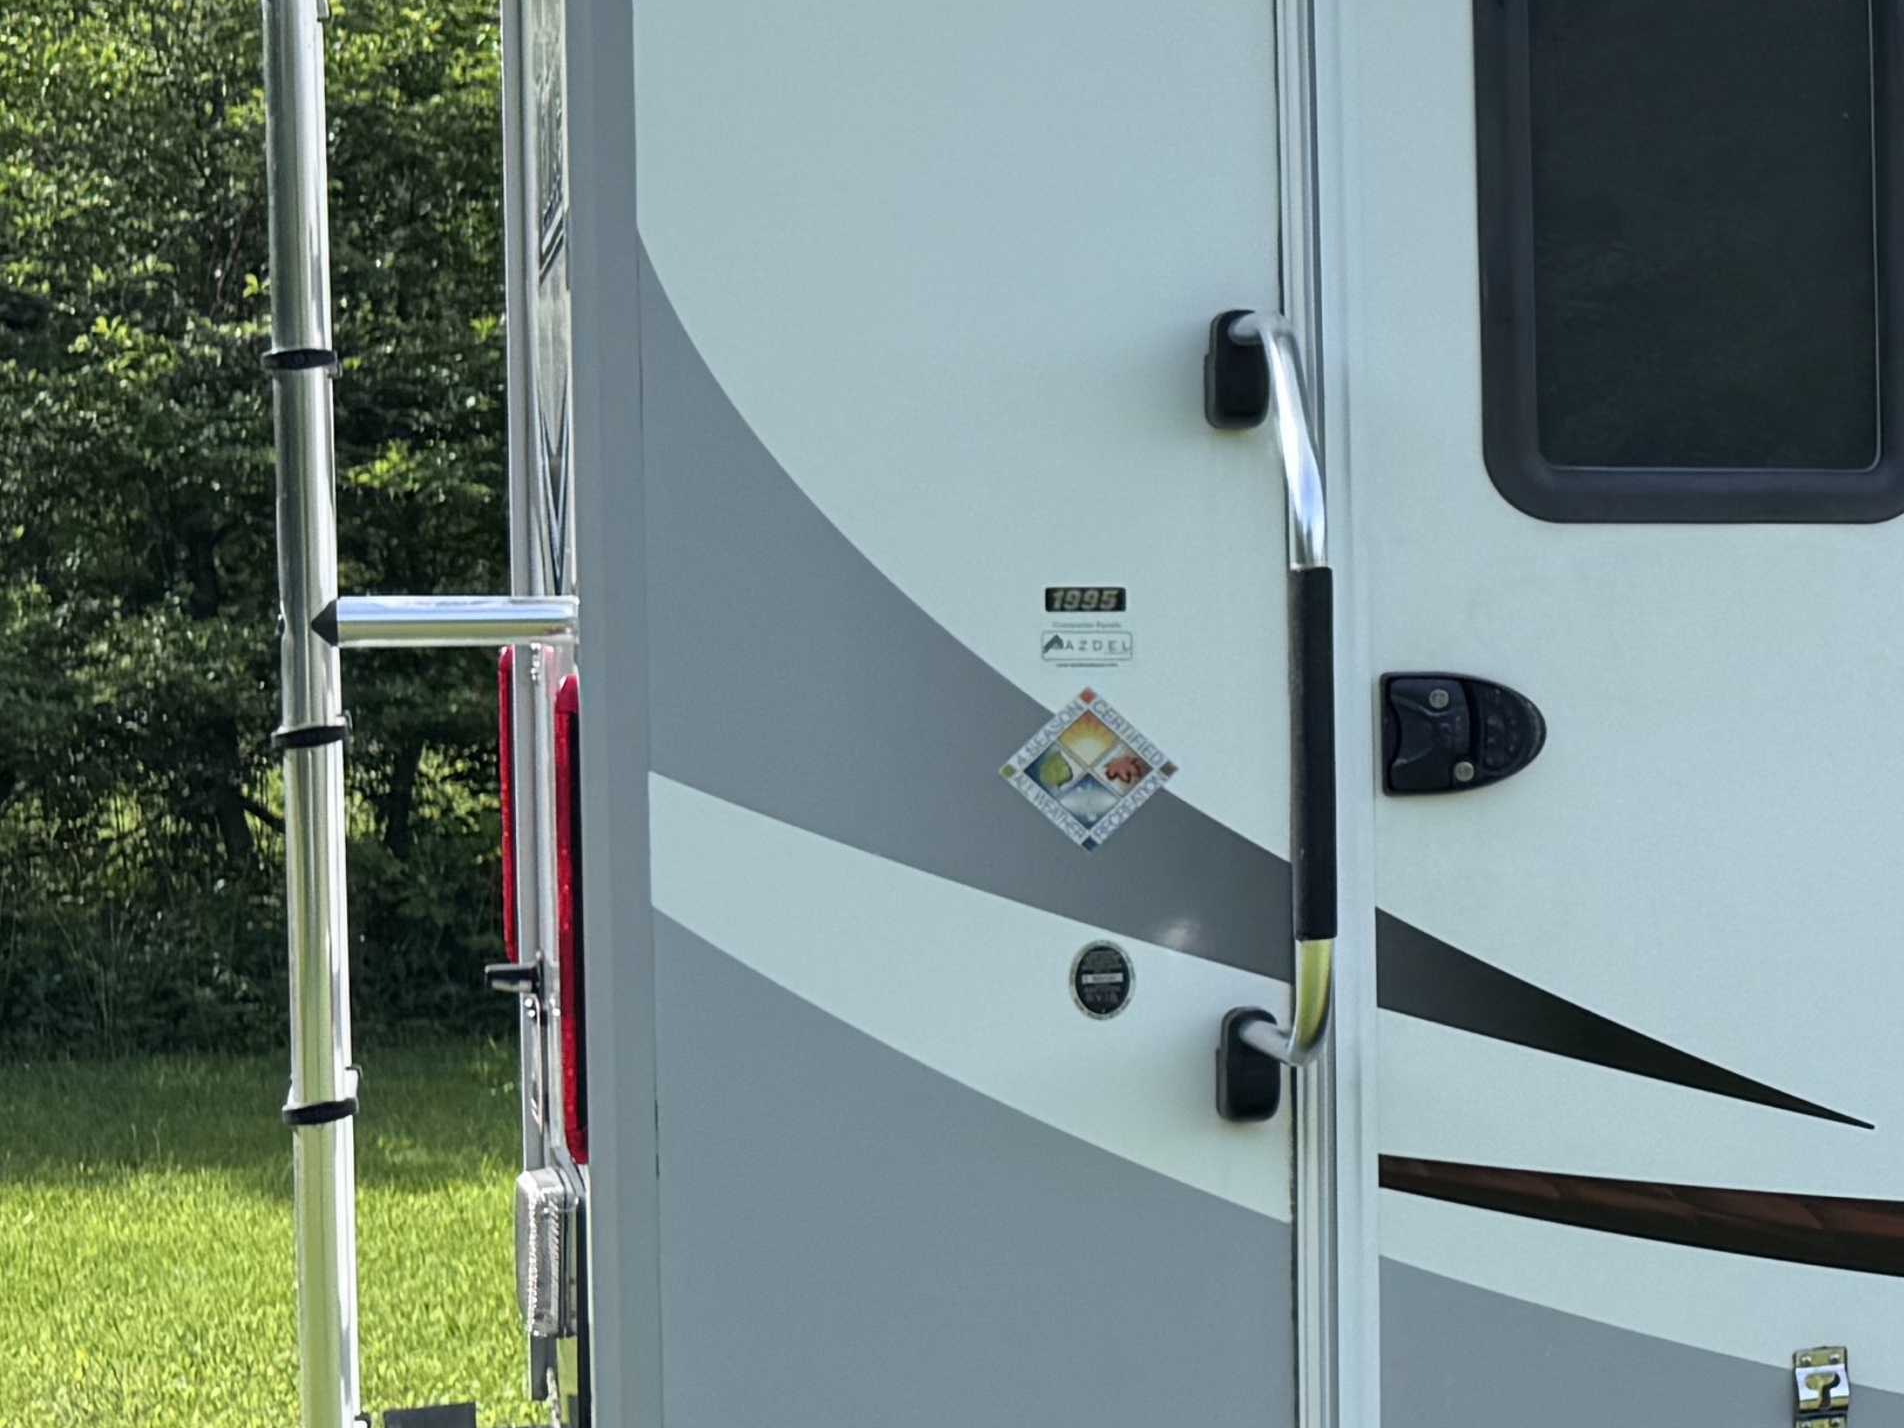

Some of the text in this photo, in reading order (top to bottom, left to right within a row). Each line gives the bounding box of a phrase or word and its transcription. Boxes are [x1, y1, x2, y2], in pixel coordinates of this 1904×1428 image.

[1053, 589, 1119, 610] 1995
[1024, 699, 1084, 758] SEASON
[1093, 699, 1165, 766] CERTIFIED
[1034, 789, 1087, 841] WEATHER
[1092, 774, 1164, 840] RECREATION
